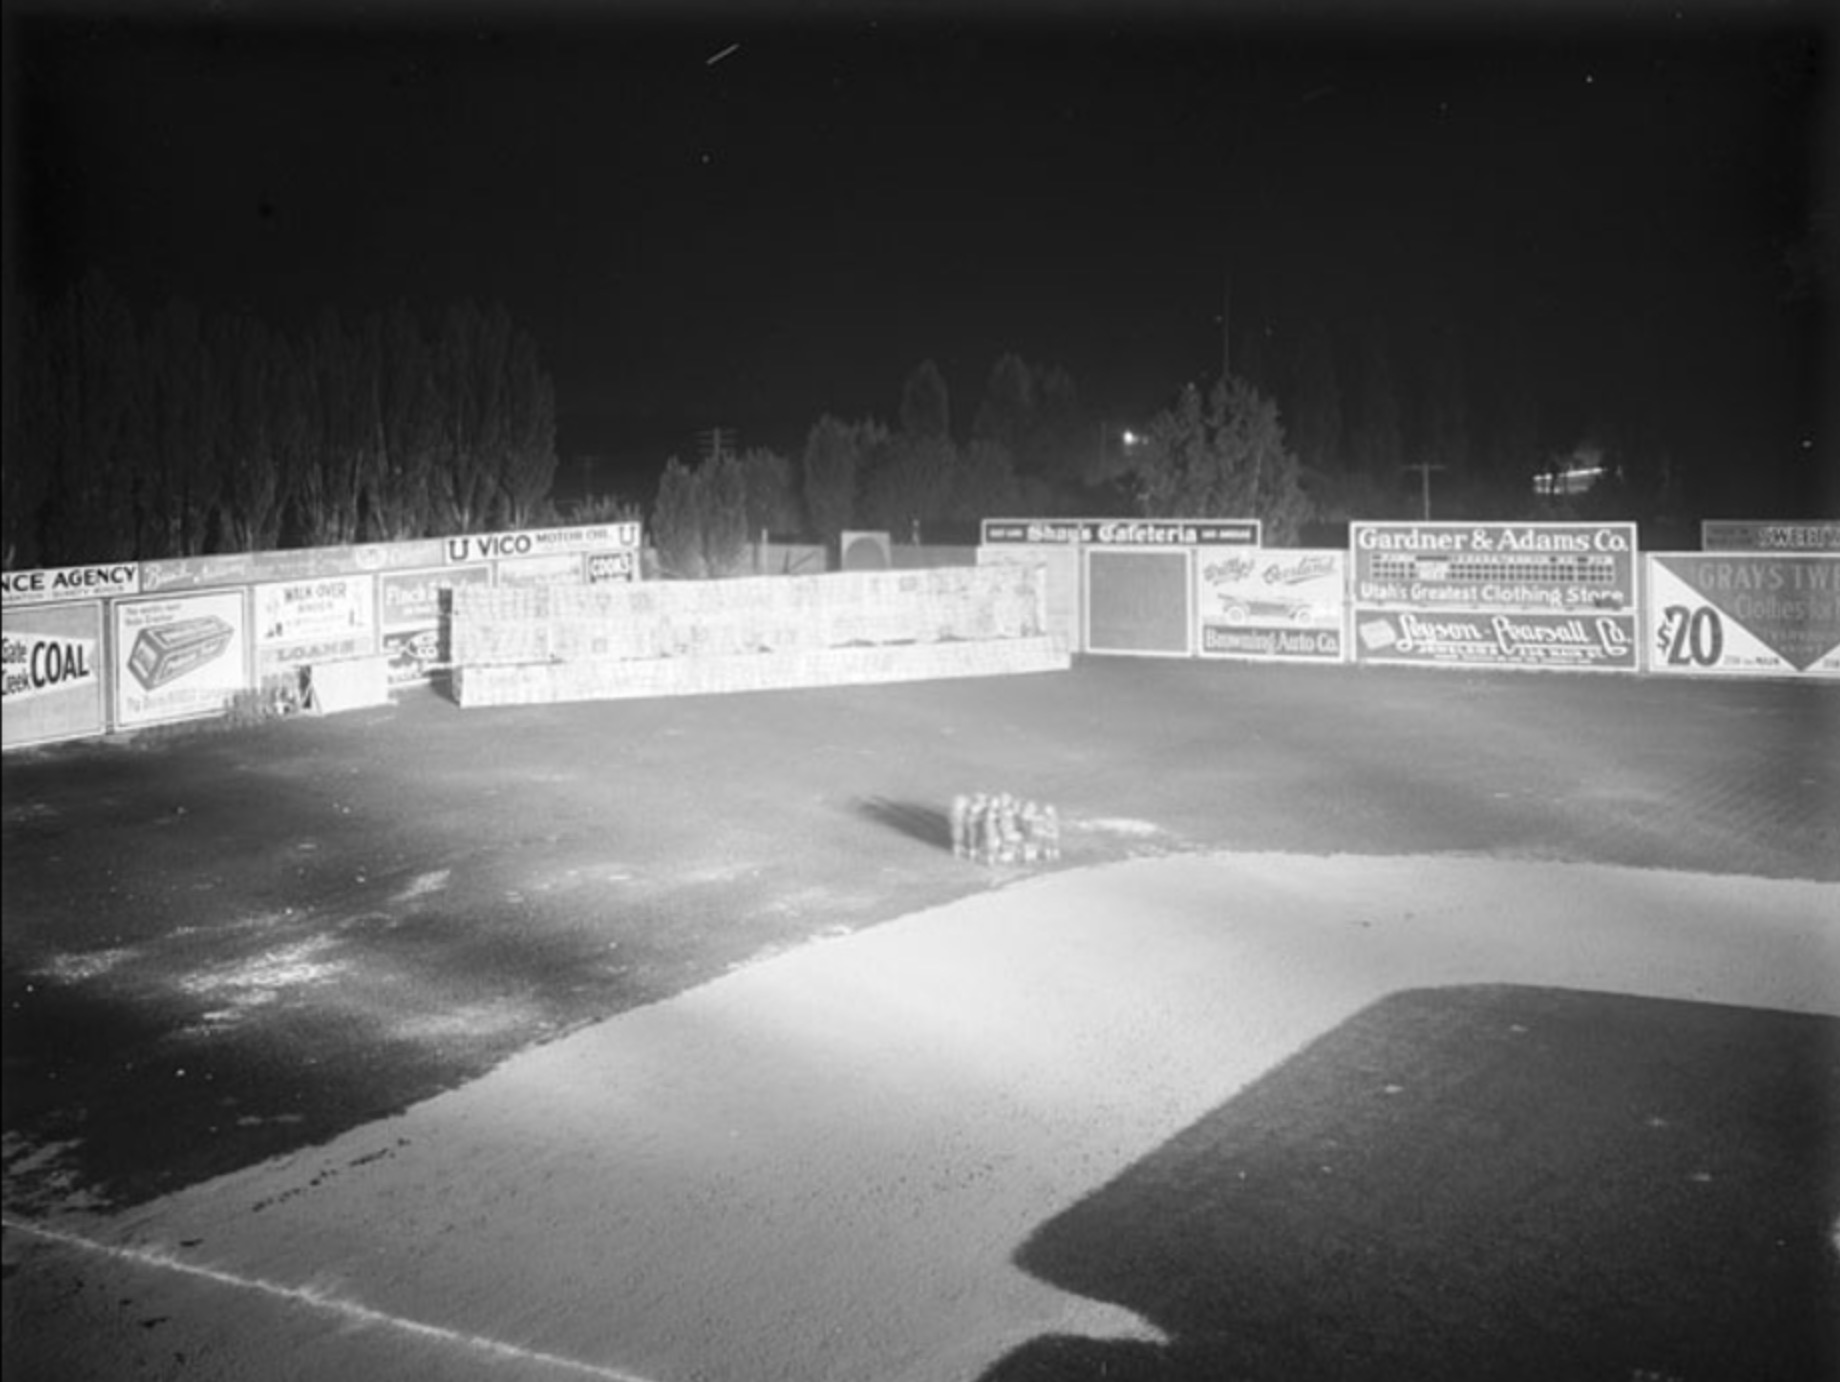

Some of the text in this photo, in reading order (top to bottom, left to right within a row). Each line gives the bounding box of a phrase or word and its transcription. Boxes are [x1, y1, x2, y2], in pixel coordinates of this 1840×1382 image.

[450, 538, 469, 561] U
[477, 534, 532, 557] VICO
[618, 525, 637, 547] U
[1097, 521, 1198, 544] Cafeteria
[1358, 528, 1629, 552] Gardner & Adams Co.
[51, 565, 136, 589] AGENCY
[1698, 560, 1785, 590] GRAYS
[1360, 582, 1624, 607] Utah's Greatest Clothing Store
[1275, 630, 1316, 653] Auto
[1656, 604, 1723, 667] $20
[30, 640, 91, 689] COAL
